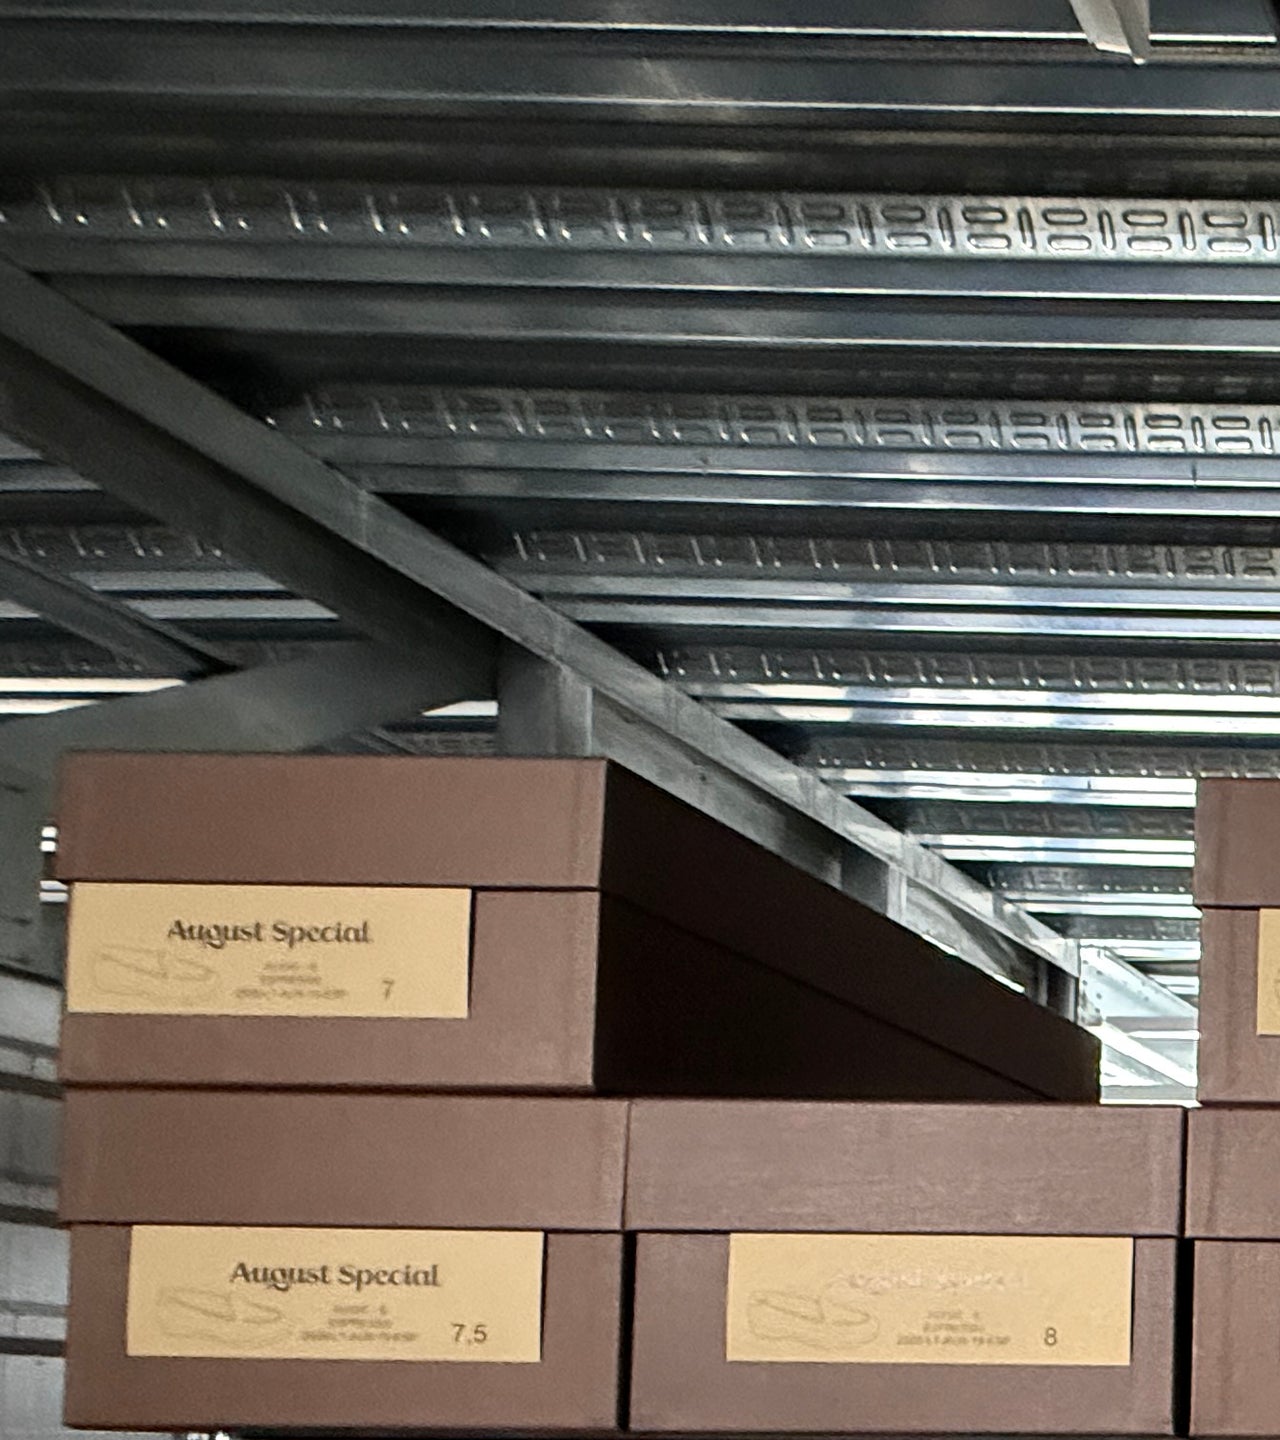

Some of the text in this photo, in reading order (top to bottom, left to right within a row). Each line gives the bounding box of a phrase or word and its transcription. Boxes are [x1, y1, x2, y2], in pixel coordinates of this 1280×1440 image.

[168, 920, 372, 949] August Special
[382, 979, 395, 1000] 7
[230, 1263, 440, 1292] August Special
[1044, 1327, 1058, 1347] 8
